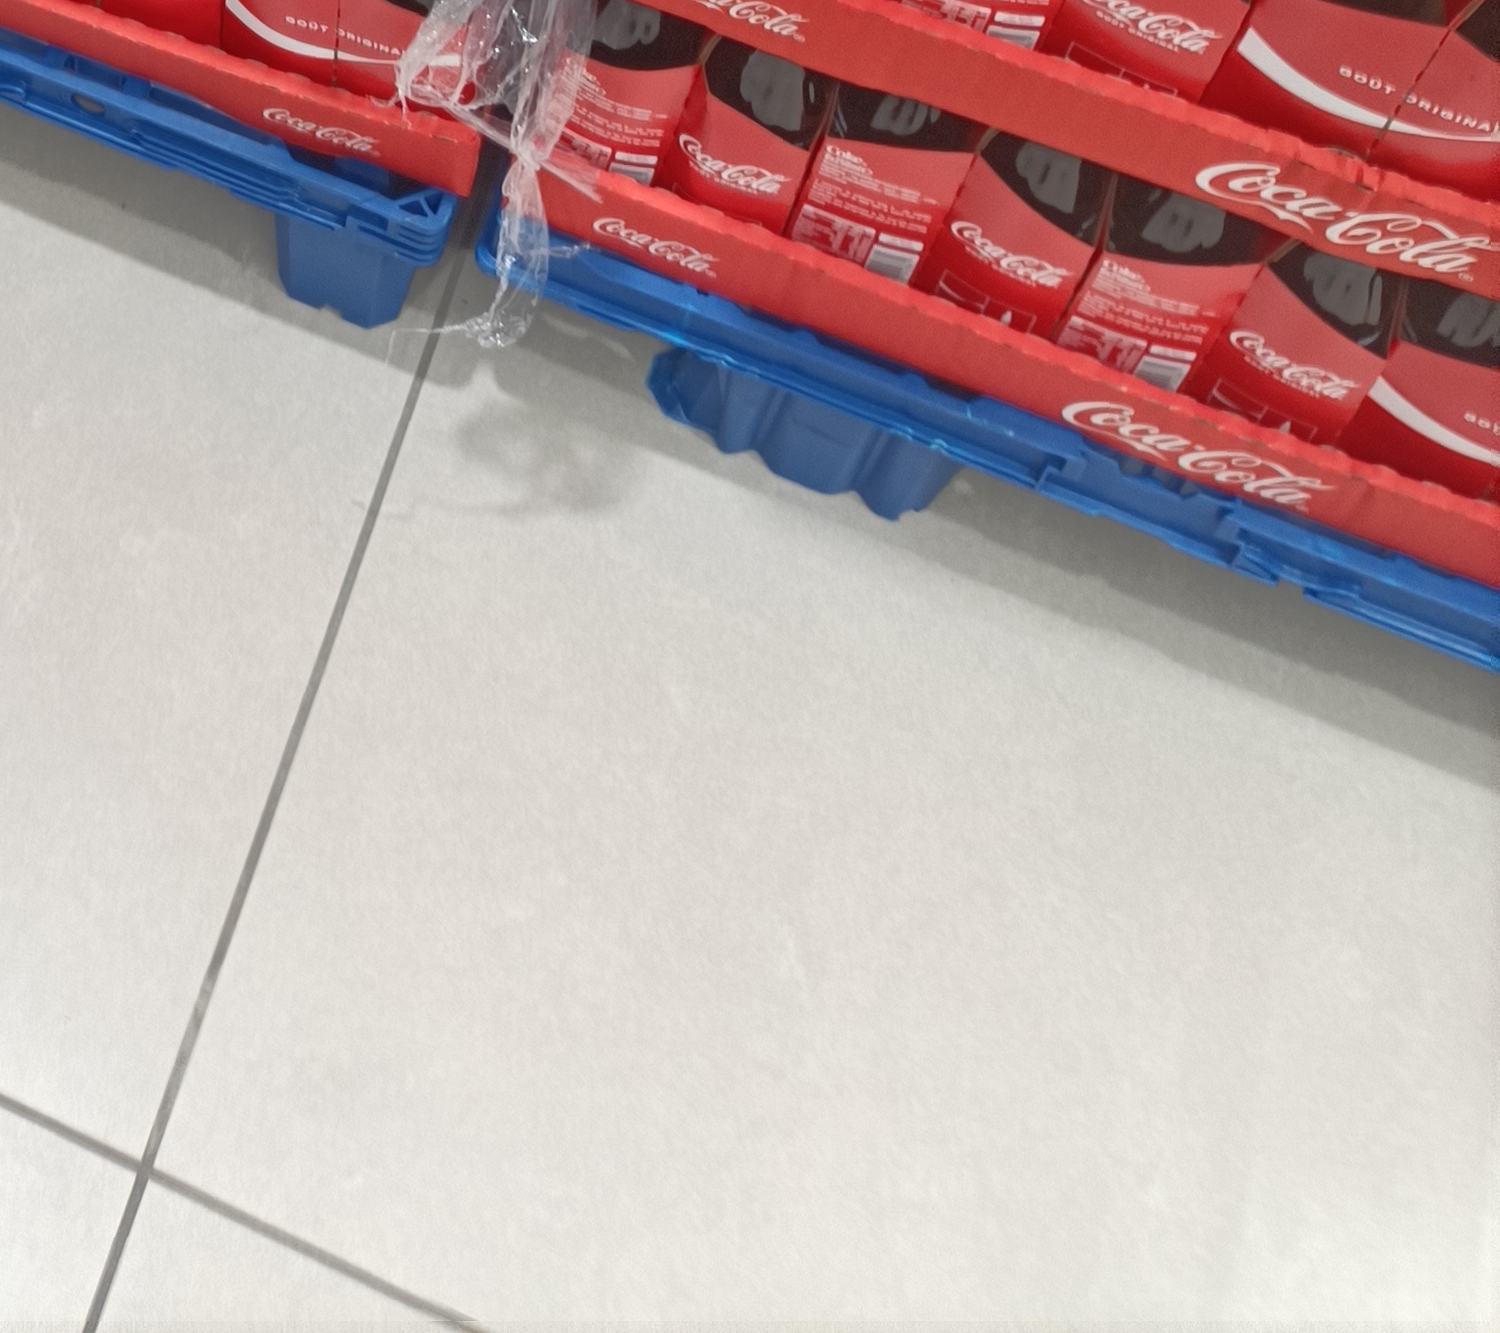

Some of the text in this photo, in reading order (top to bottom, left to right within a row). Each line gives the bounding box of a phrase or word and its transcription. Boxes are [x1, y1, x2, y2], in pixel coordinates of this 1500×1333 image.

[334, 26, 407, 57] ORIGINA
[1337, 64, 1397, 96] GOÛT
[678, 133, 792, 197] Coca-Cola
[593, 217, 719, 275] Coca-Cola
[1195, 162, 1498, 276] Coca-Cola
[950, 220, 1077, 290] Coca-Cola
[1229, 330, 1362, 401] Coca-Cola
[1061, 400, 1339, 506] Coca-Cola
